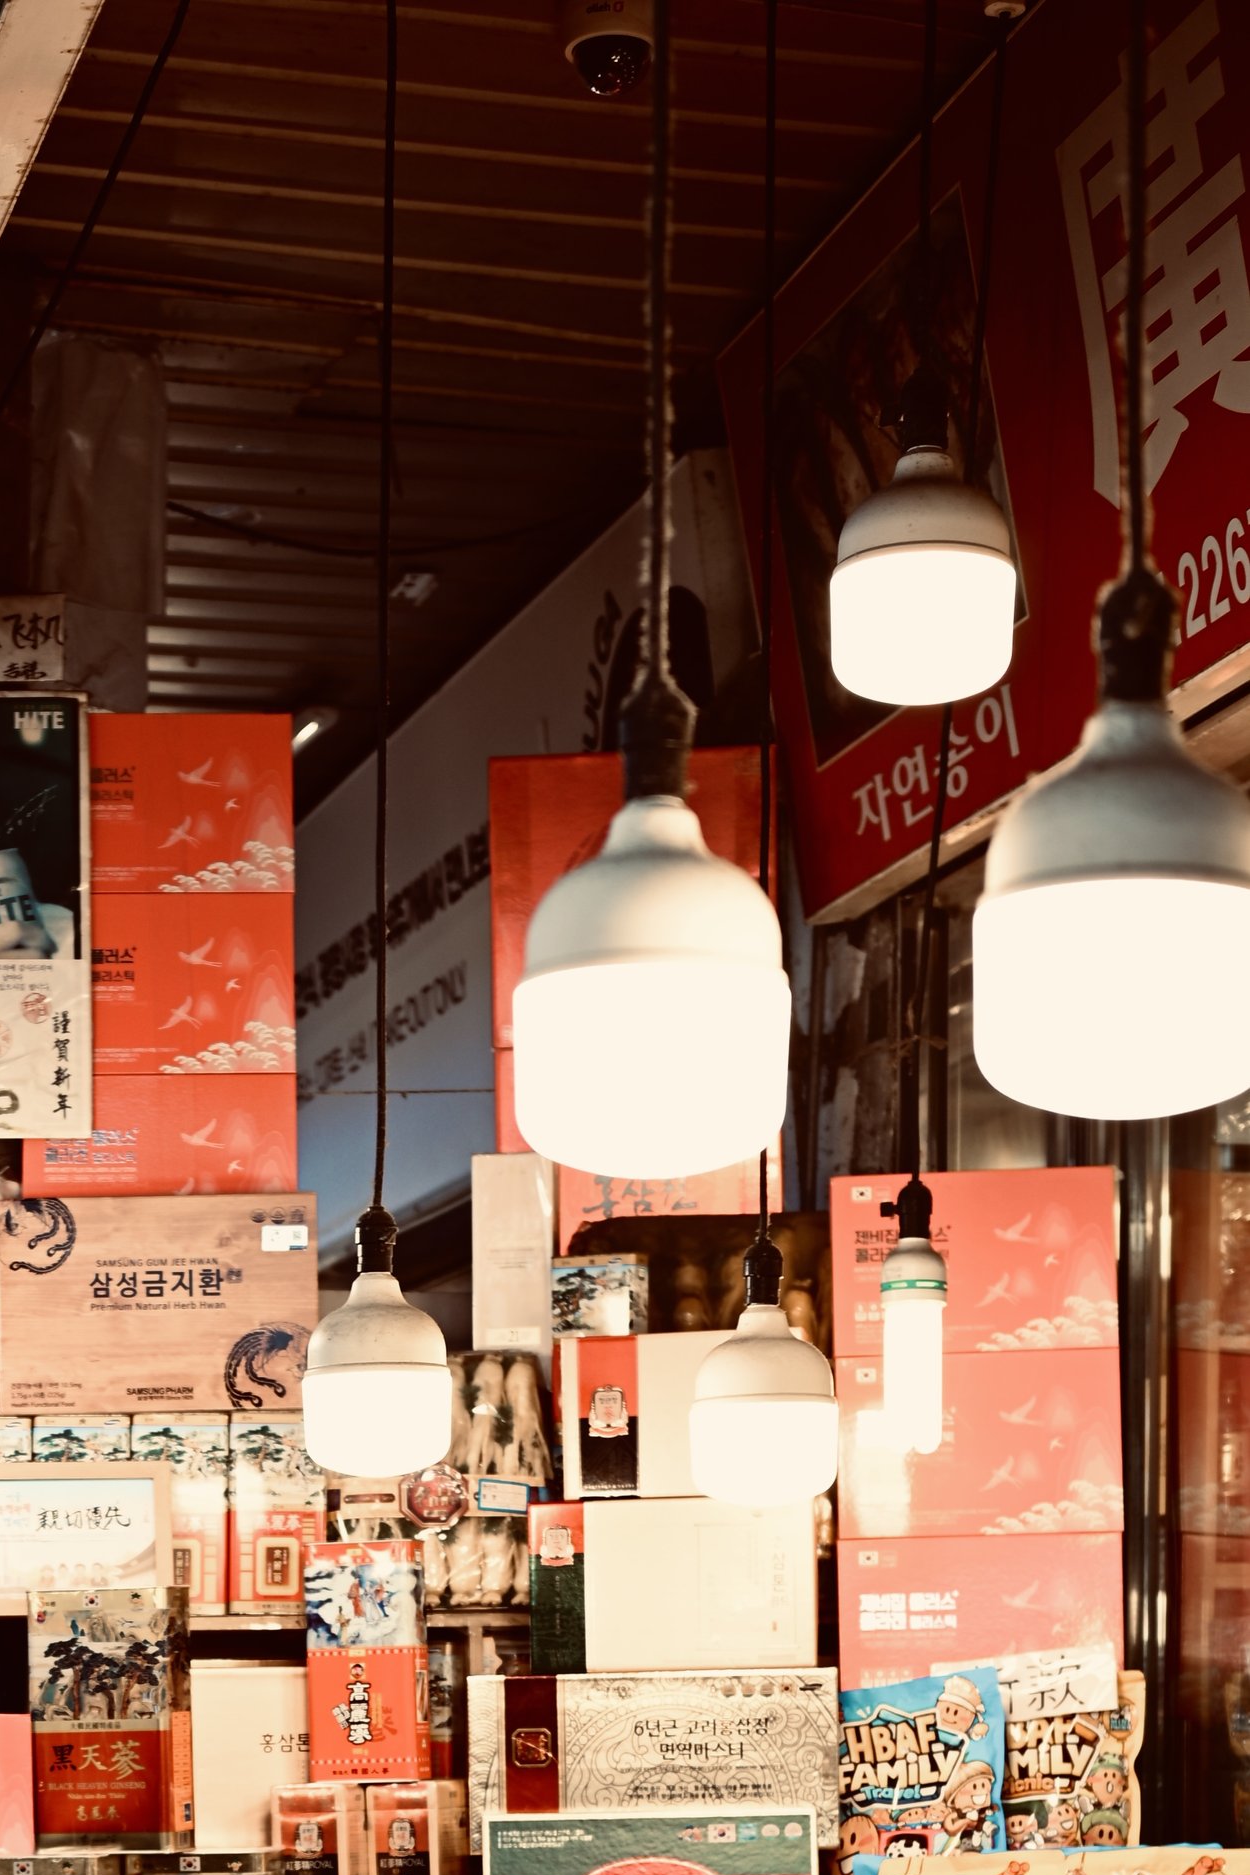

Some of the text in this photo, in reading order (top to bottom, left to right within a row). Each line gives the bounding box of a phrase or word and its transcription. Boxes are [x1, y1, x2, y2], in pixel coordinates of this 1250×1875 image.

[1177, 509, 1250, 639] 226
[13, 711, 65, 729] HITE
[853, 684, 1022, 842] 자연송이
[52, 1010, 73, 1120] 謹賀新年
[96, 1257, 219, 1267] SAMSUNG GUM JEE HWAN
[89, 1268, 225, 1298] 삼성금지환
[90, 1301, 227, 1311] Premium Natural Herb Hwan
[126, 1386, 194, 1396] SAMSUNG PHARM
[36, 1506, 132, 1533] 親切優先
[634, 1717, 769, 1738] 6년근 고려홍삼정
[1007, 1716, 1072, 1751] BAF
[259, 1732, 310, 1754] 홍삼톤
[845, 1714, 938, 1765] HBAF
[48, 1781, 146, 1791] BLACK HEAVEN GINSENG
[860, 1781, 923, 1801] Travel
